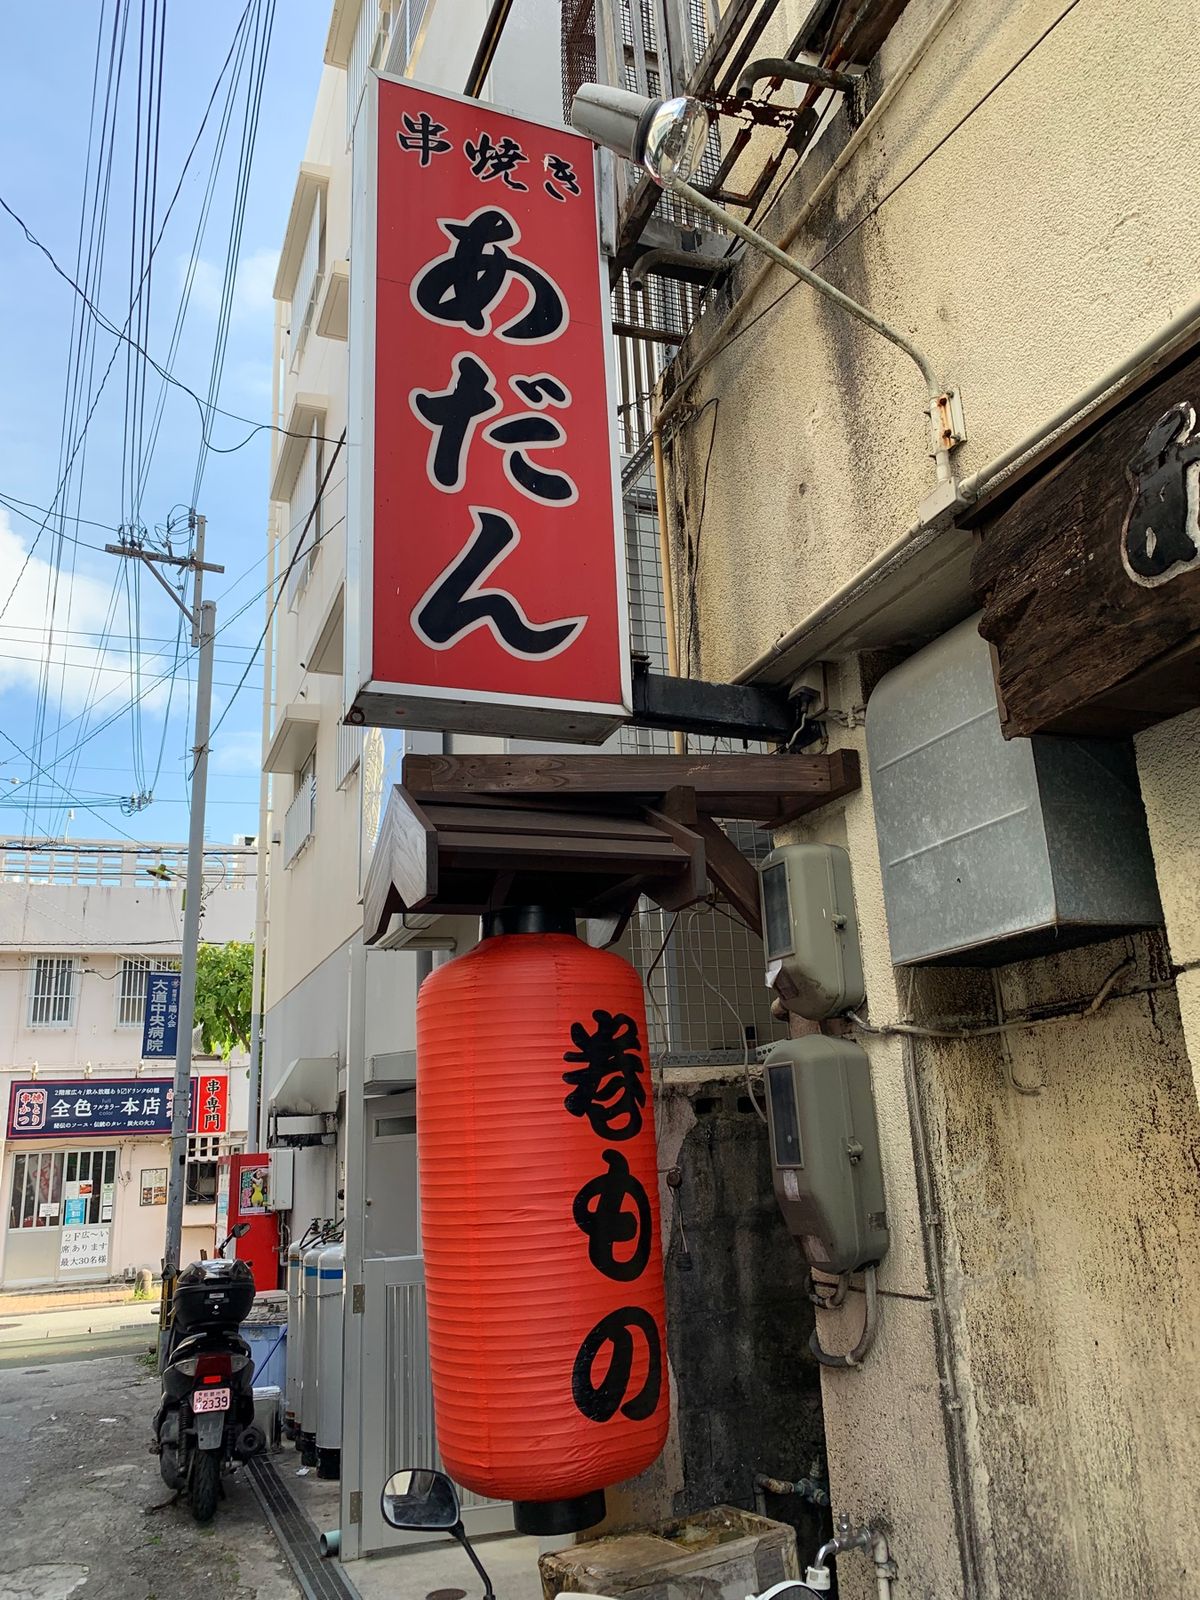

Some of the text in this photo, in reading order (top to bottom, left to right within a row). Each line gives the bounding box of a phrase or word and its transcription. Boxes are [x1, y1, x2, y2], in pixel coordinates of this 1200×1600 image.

[396, 110, 582, 203] 串焼き
[408, 205, 590, 662] あだん
[146, 979, 168, 1052] 大道中央病院
[51, 1099, 92, 1118] 全色
[120, 1096, 161, 1116] 本店
[203, 1079, 220, 1130] 串専門
[562, 1009, 661, 1423] 巻もの
[60, 1254, 106, 1266] 最大30名様
[61, 1242, 107, 1253] 席あります
[202, 1396, 228, 1410] 2339
